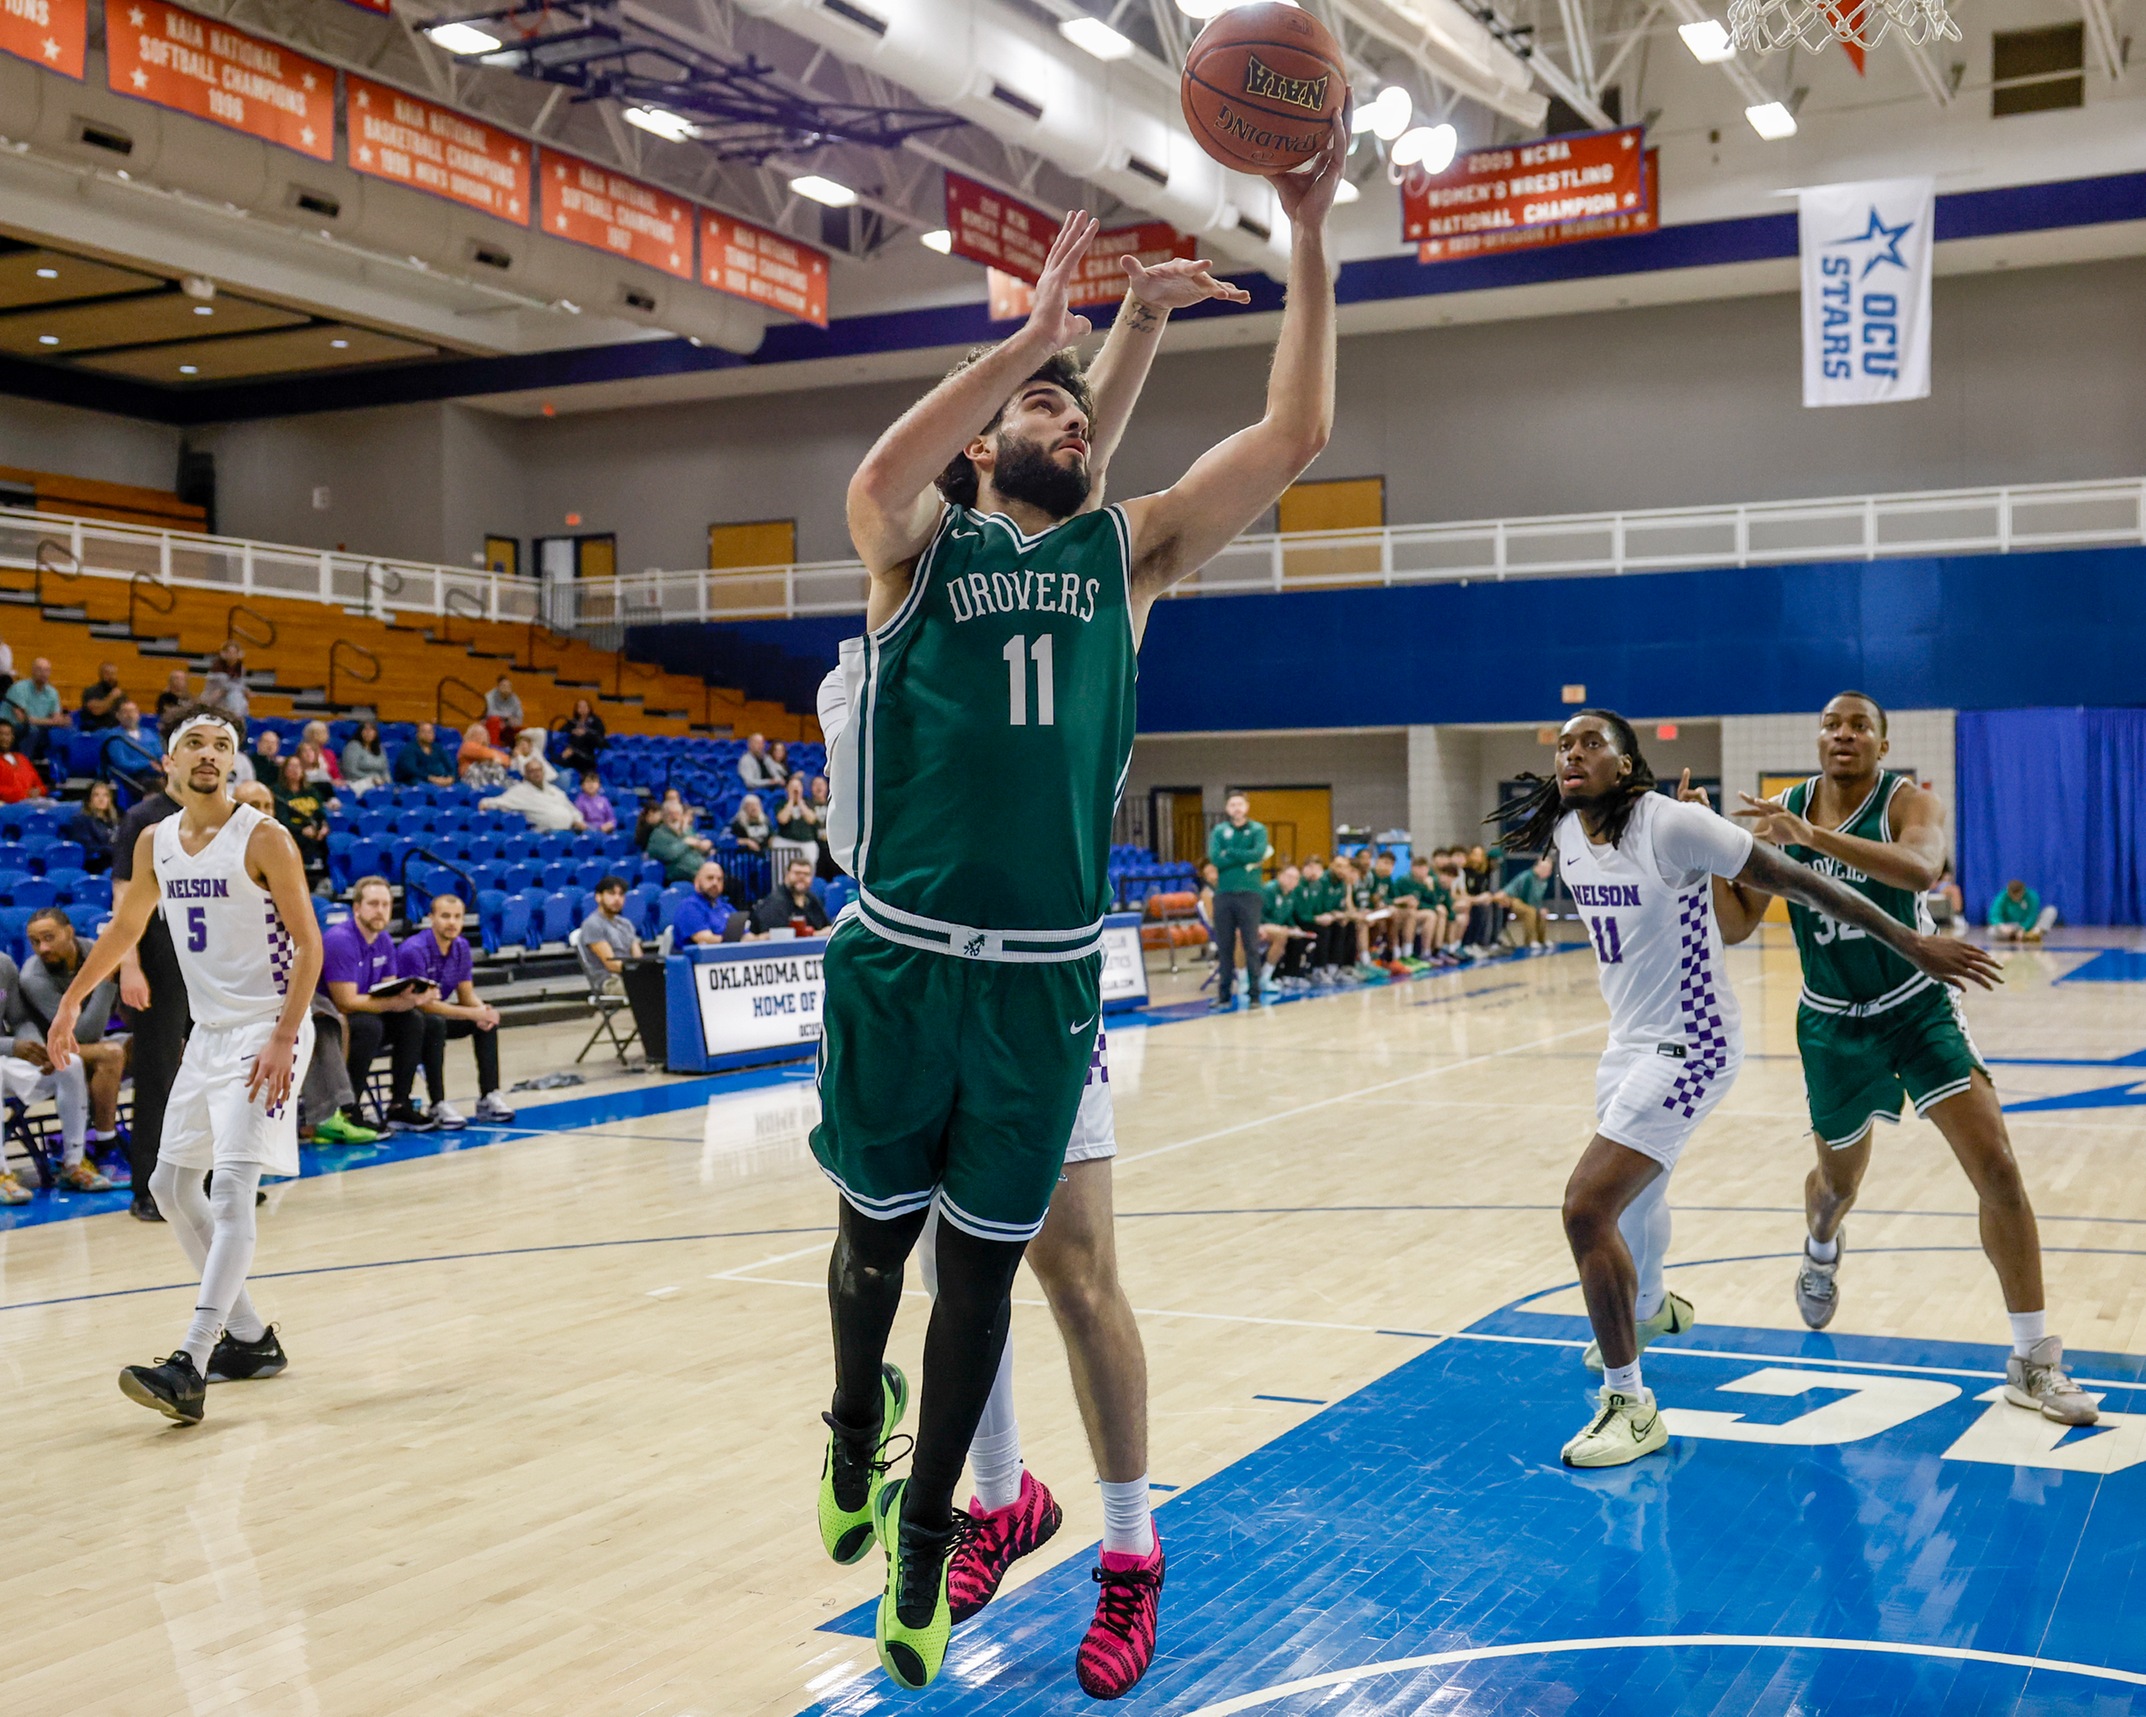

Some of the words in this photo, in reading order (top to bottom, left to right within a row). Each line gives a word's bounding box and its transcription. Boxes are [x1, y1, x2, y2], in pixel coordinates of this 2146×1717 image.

[139, 34, 218, 84] SOFTBALL
[221, 63, 307, 117] CHAMPIONS
[1246, 55, 1330, 111] NAIA
[1215, 104, 1323, 152] SPALDING
[1511, 163, 1614, 196] WRESTLING
[1428, 208, 1514, 234] NATIONAL
[1523, 192, 1617, 224] CHAMPION
[1822, 257, 1851, 379] STARS
[1861, 293, 1899, 380] OCU
[946, 569, 1100, 623] DROVERS
[1003, 634, 1054, 725] 11
[167, 879, 229, 898] NELSON
[1572, 884, 1642, 906] NELSON
[187, 907, 208, 952] 5
[1591, 915, 1624, 963] 11
[709, 961, 800, 991] OKLAHOMA
[753, 992, 796, 1018] HOME
[800, 990, 817, 1012] OF
